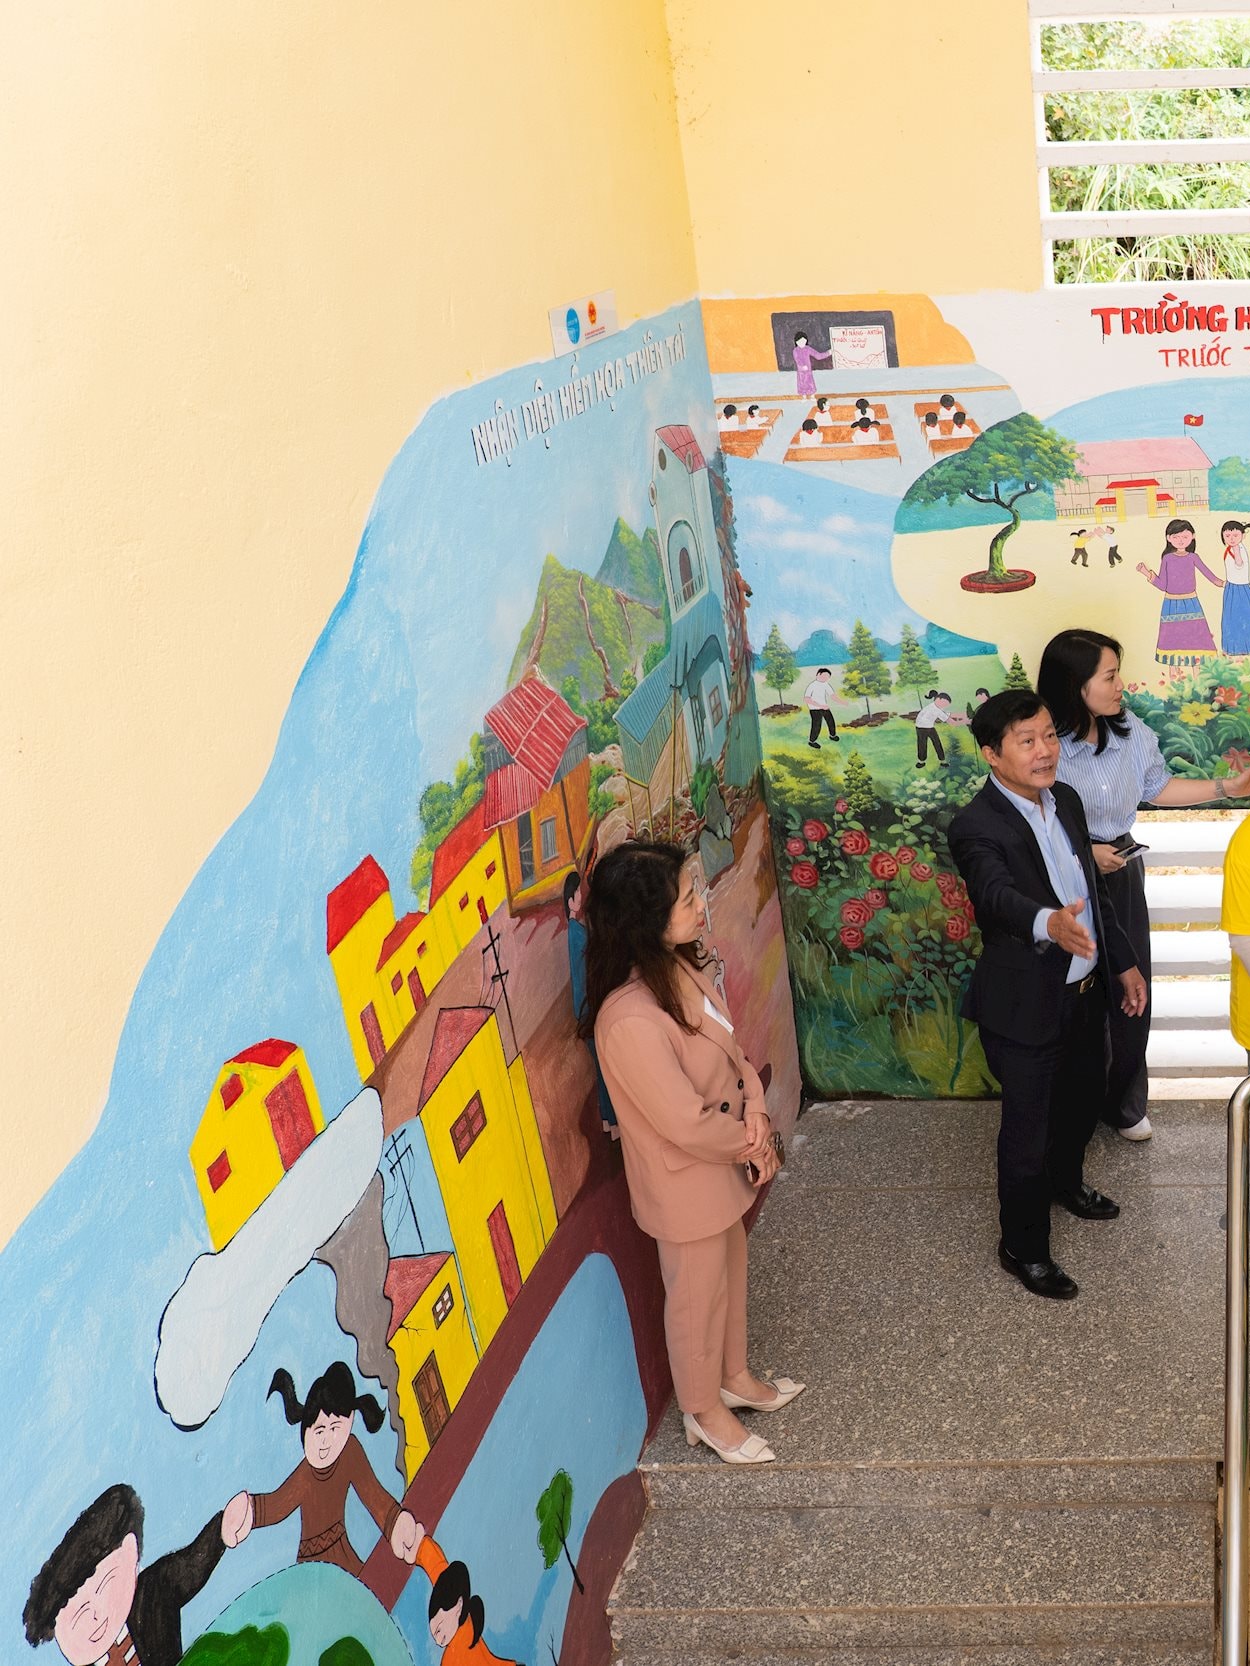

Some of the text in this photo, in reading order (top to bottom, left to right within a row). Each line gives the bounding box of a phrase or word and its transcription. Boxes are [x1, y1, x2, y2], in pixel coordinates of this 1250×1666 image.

[1091, 292, 1229, 336] TRƯỜNG
[1158, 336, 1233, 369] TRƯỚC
[521, 378, 558, 450] DIỆN
